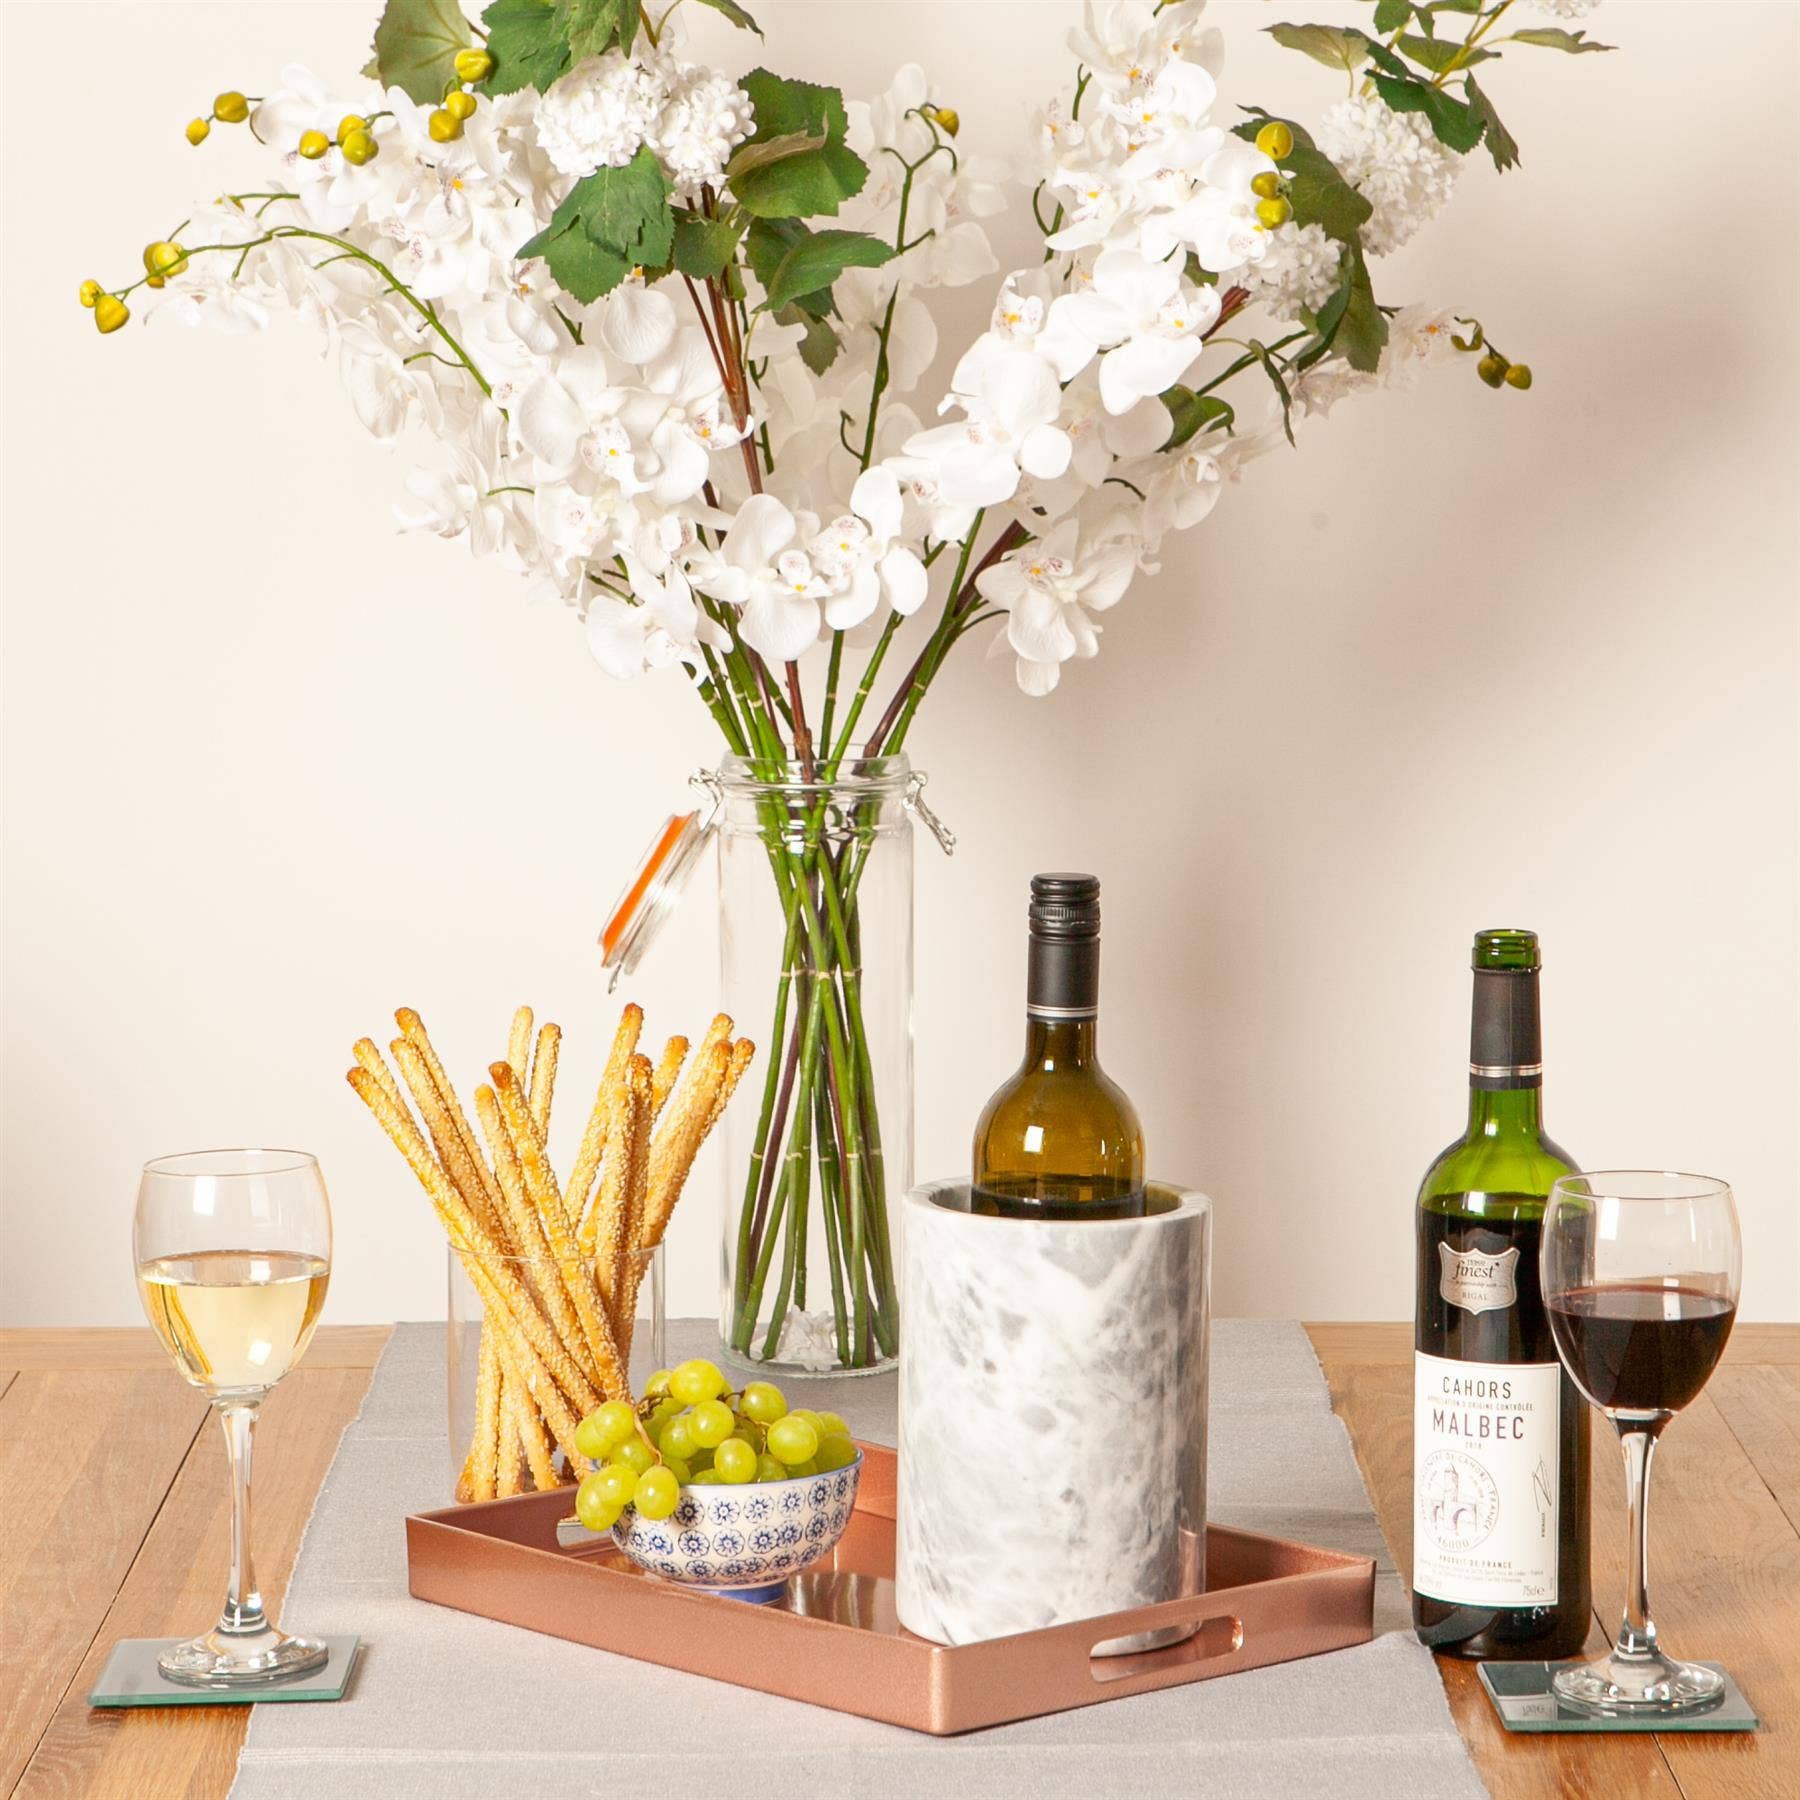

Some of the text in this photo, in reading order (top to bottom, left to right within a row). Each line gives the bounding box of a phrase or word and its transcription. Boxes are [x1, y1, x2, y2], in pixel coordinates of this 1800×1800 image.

[1443, 1376, 1511, 1399] CAHORS
[1433, 1407, 1524, 1440] MALBEC
[1482, 1560, 1512, 1569] FRANCE
